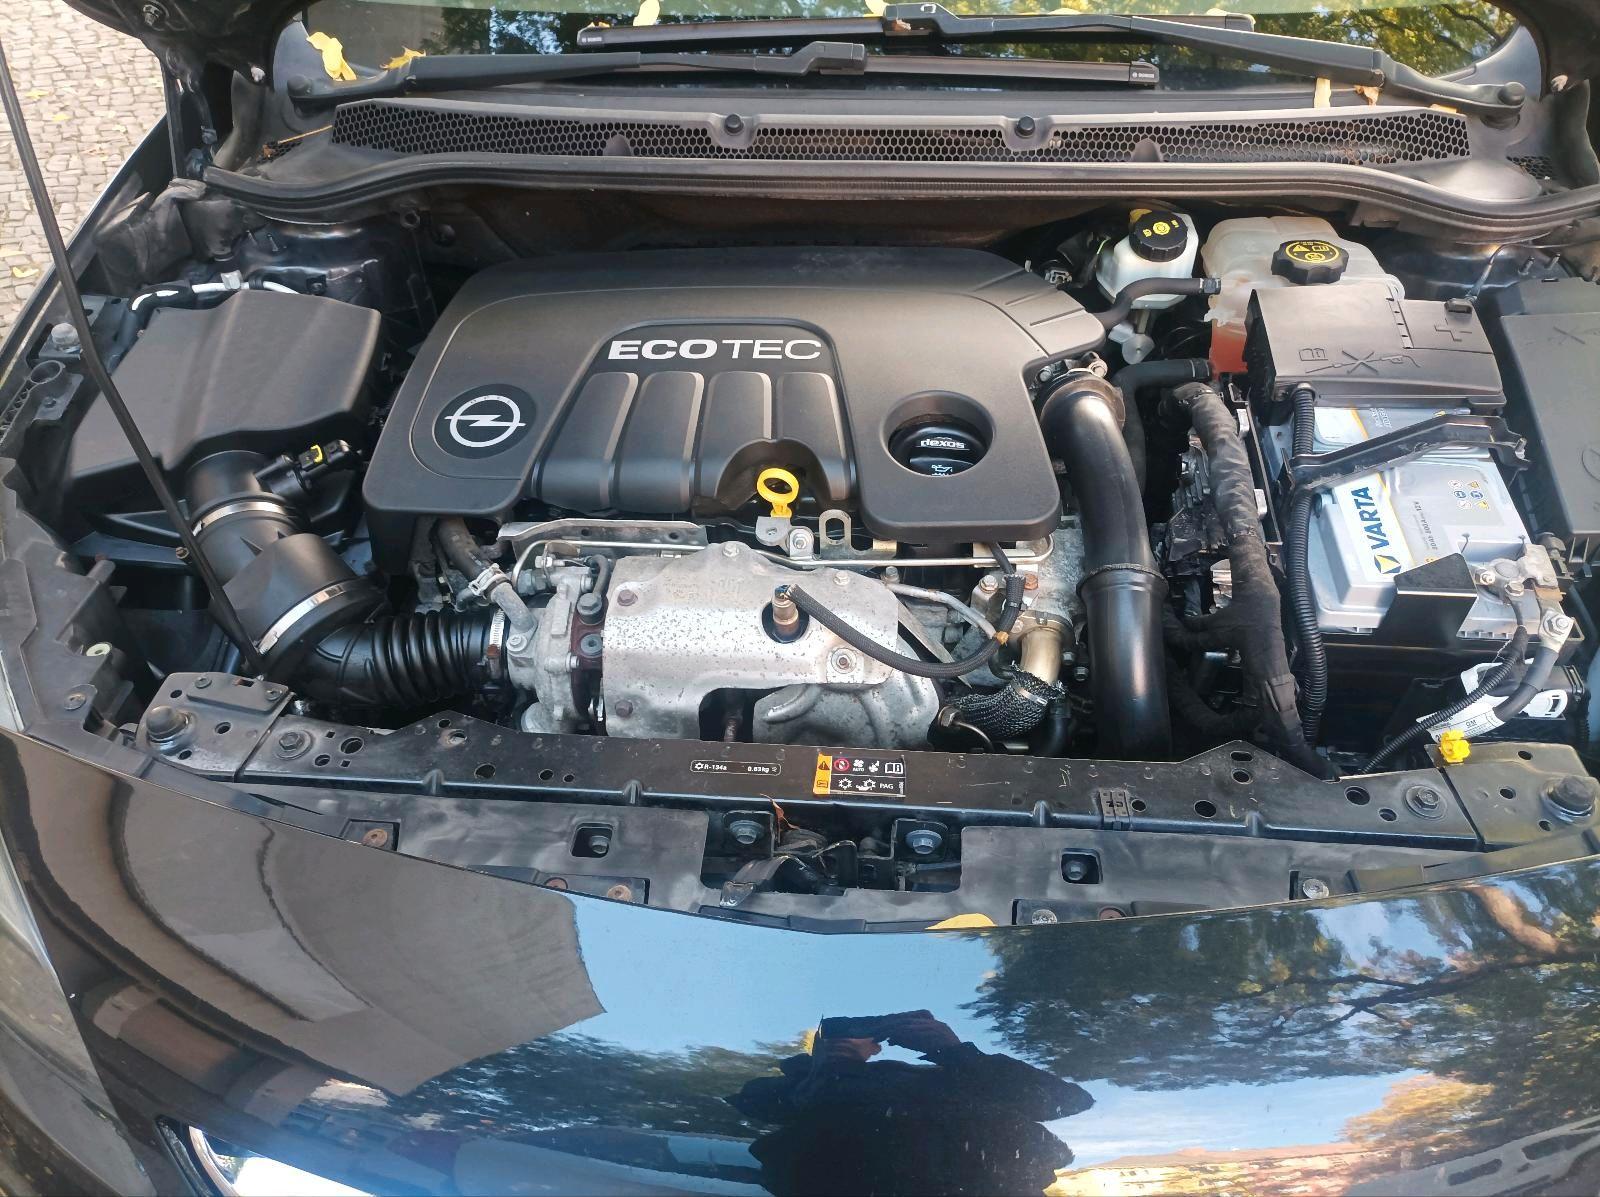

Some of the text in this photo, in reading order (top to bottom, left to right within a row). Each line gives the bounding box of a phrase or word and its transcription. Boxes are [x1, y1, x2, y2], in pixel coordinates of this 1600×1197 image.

[608, 339, 822, 360] ECOTEC
[920, 438, 965, 449] dexos
[1350, 486, 1390, 550] VARTA
[704, 763, 727, 771] R-134a
[879, 782, 894, 790] PAG
